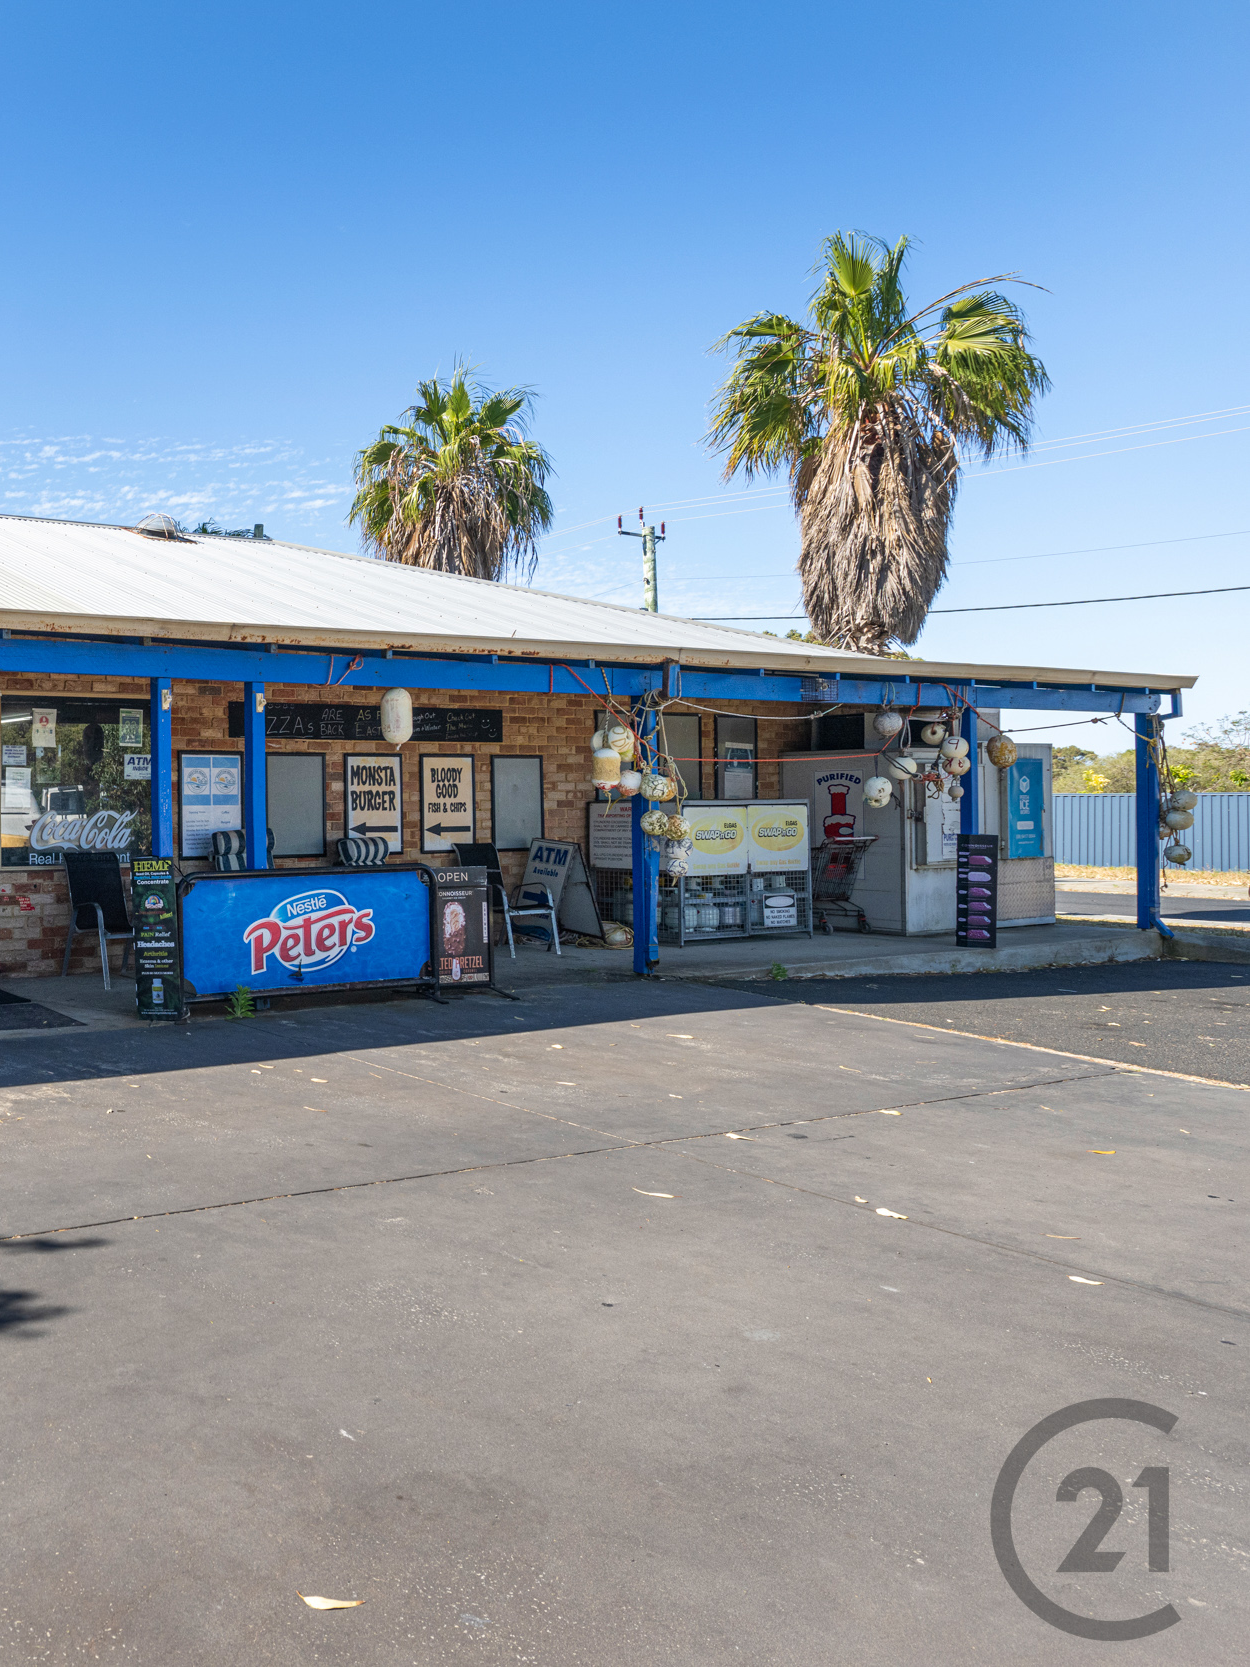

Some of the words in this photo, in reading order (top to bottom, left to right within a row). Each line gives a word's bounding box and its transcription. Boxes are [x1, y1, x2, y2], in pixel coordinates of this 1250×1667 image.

[322, 709, 343, 720] ARE
[321, 724, 344, 735] BACK
[127, 757, 151, 766] ATM
[350, 765, 396, 787] MONSTA
[430, 768, 463, 784] BLOODY
[816, 773, 861, 786] PURIFIED
[436, 783, 459, 799] GOOD
[350, 790, 396, 811] BURGER
[1020, 800, 1030, 810] ICE
[428, 802, 441, 813] FISH
[442, 802, 448, 813] &
[450, 802, 467, 813] CHIPS
[30, 808, 139, 850] Coca-Cola
[30, 853, 54, 864] Real
[532, 846, 569, 866] ATM
[133, 860, 172, 872] HEMP
[533, 866, 559, 877] Available
[438, 872, 468, 883] OPEN
[286, 894, 327, 917] Nestlé
[244, 906, 375, 975] Peters
